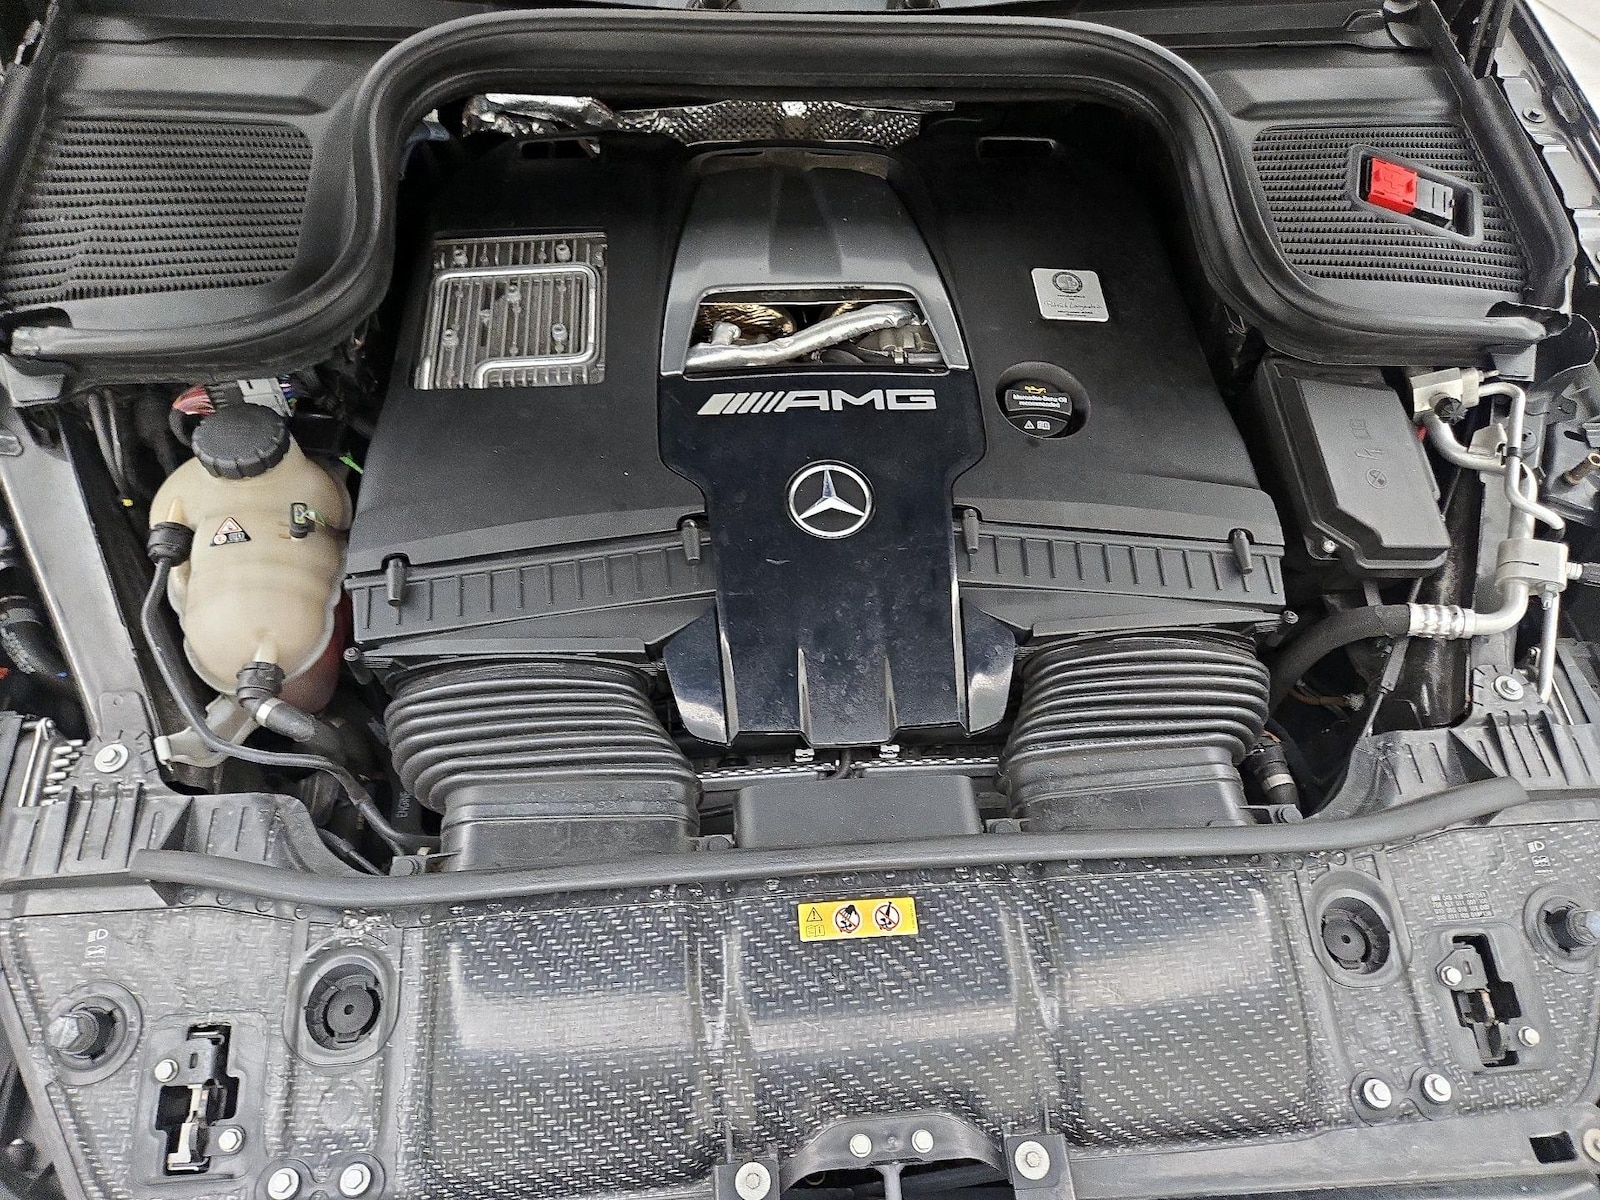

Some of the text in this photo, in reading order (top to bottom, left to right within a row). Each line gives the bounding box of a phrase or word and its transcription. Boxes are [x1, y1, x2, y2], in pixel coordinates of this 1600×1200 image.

[774, 389, 937, 413] AMG
[1012, 393, 1068, 404] Mercedes-Benz Oil
[1018, 400, 1061, 409] recommended
